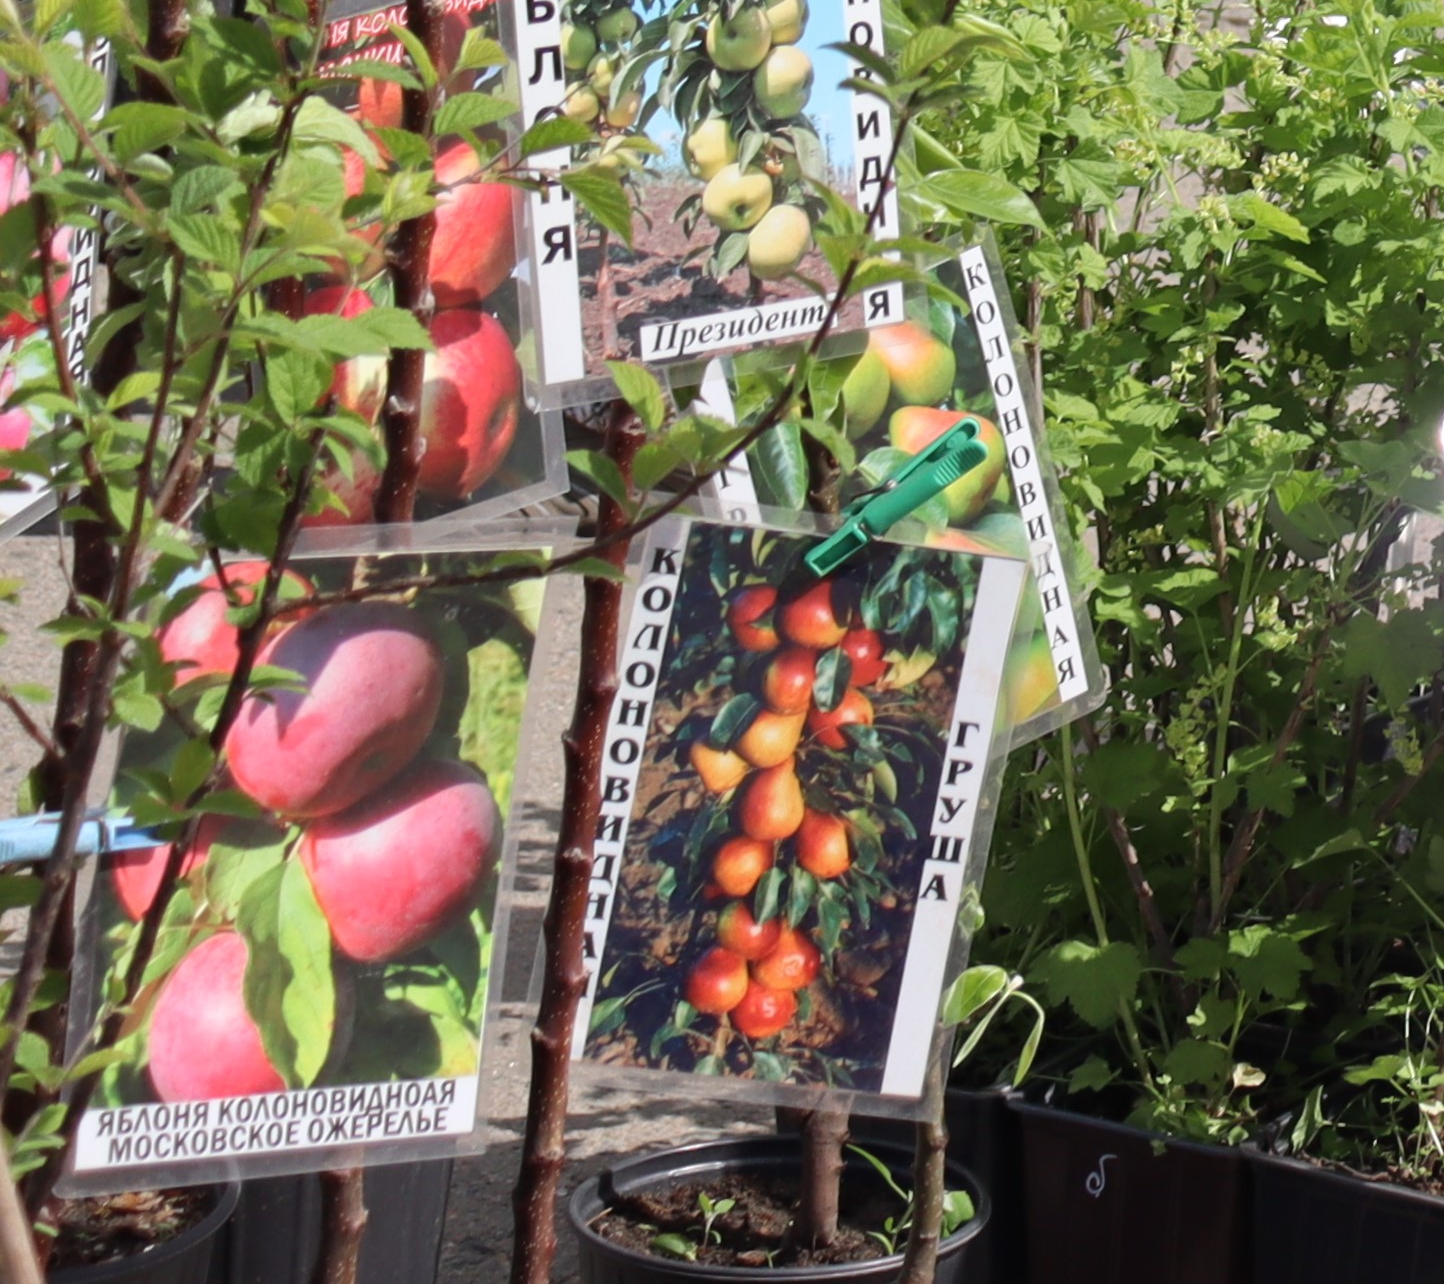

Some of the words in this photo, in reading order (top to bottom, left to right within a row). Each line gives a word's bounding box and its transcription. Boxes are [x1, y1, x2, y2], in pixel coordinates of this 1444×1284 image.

[652, 303, 826, 357] Президент
[965, 262, 1077, 684] КОЛОНОВИДНАЯ
[921, 721, 981, 902] ГРУША
[97, 1101, 208, 1137] ЯБЛОНЯ
[217, 1079, 456, 1127] КОЛОНОВИДНОАЯ
[107, 1120, 300, 1164] МОСКОВСКОЕ
[307, 1107, 449, 1142] ОЖЕРЕЛЬЕ
